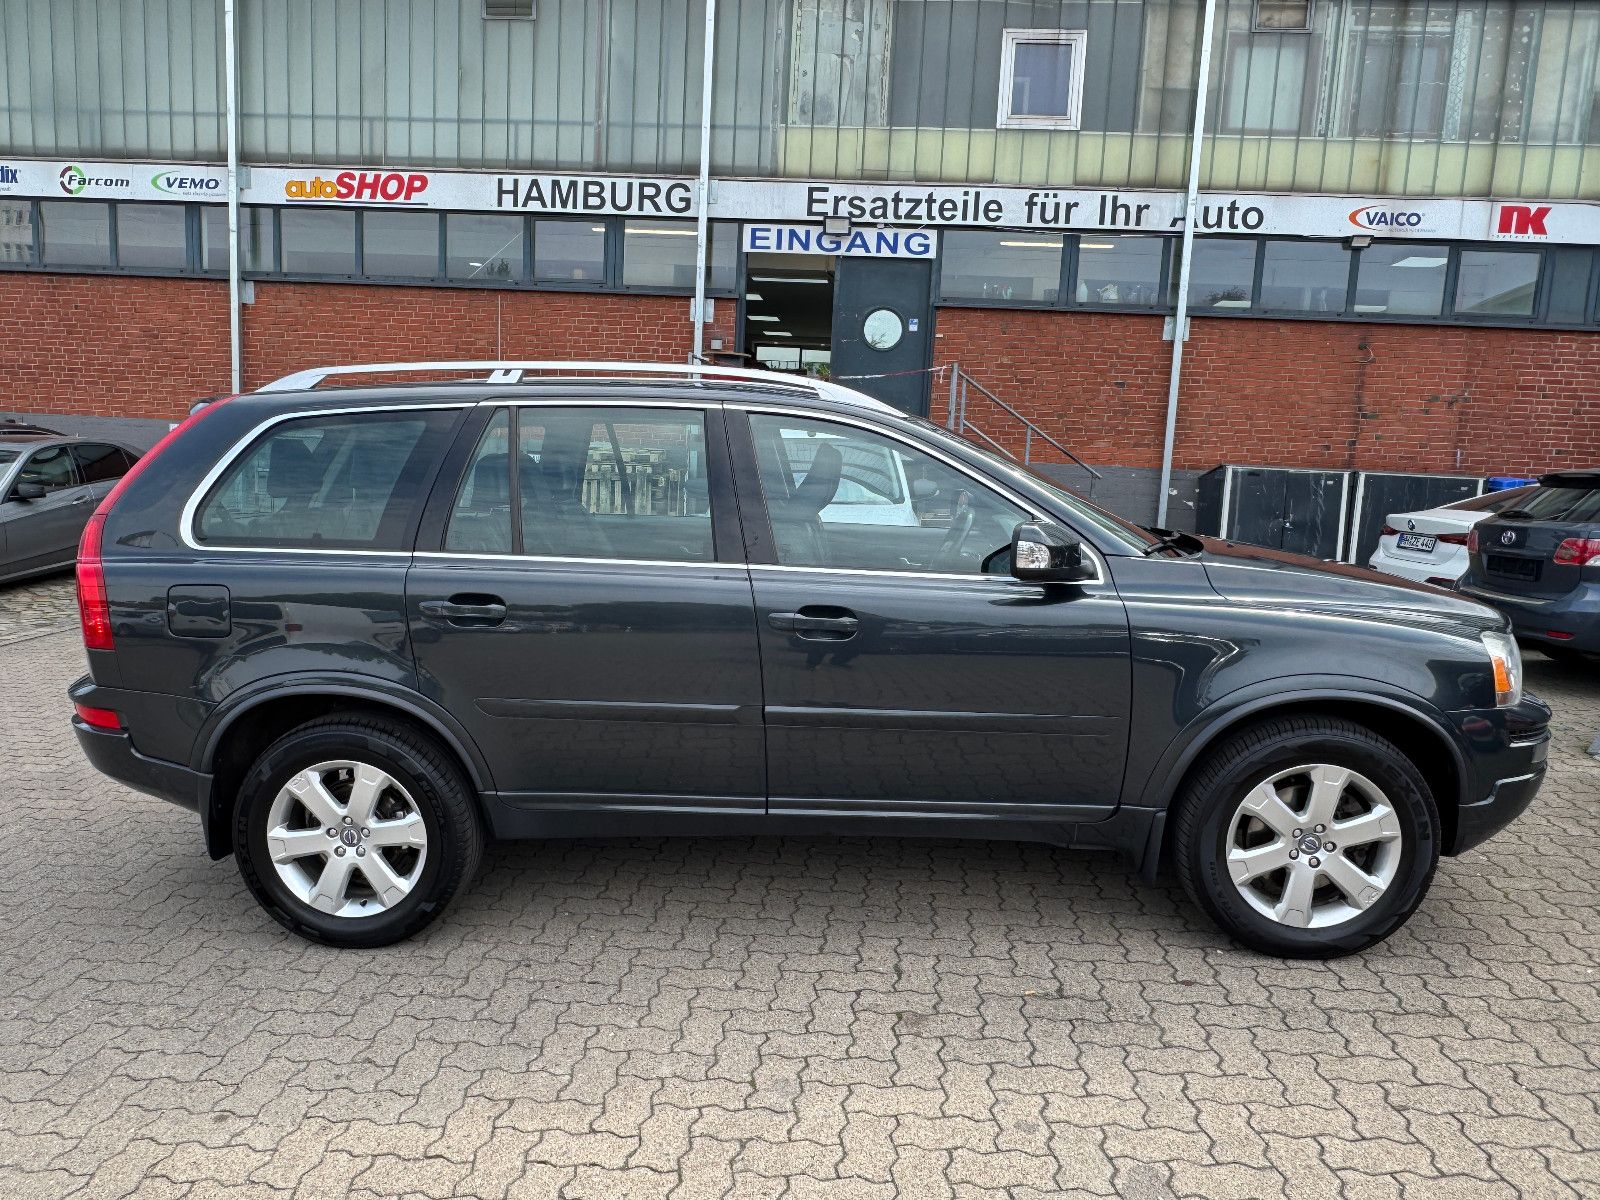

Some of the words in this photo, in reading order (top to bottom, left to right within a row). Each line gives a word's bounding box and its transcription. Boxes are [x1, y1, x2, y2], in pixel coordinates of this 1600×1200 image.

[66, 174, 131, 188] Farcom
[165, 176, 220, 190] VEMO
[285, 172, 428, 201] autoSHOP
[497, 177, 692, 214] HAMBURG
[806, 186, 1003, 224] Ersatzteile
[1025, 192, 1079, 226] für
[1098, 194, 1150, 227] Ihr
[1365, 211, 1422, 227] VAICO
[749, 227, 930, 256] EINGANG
